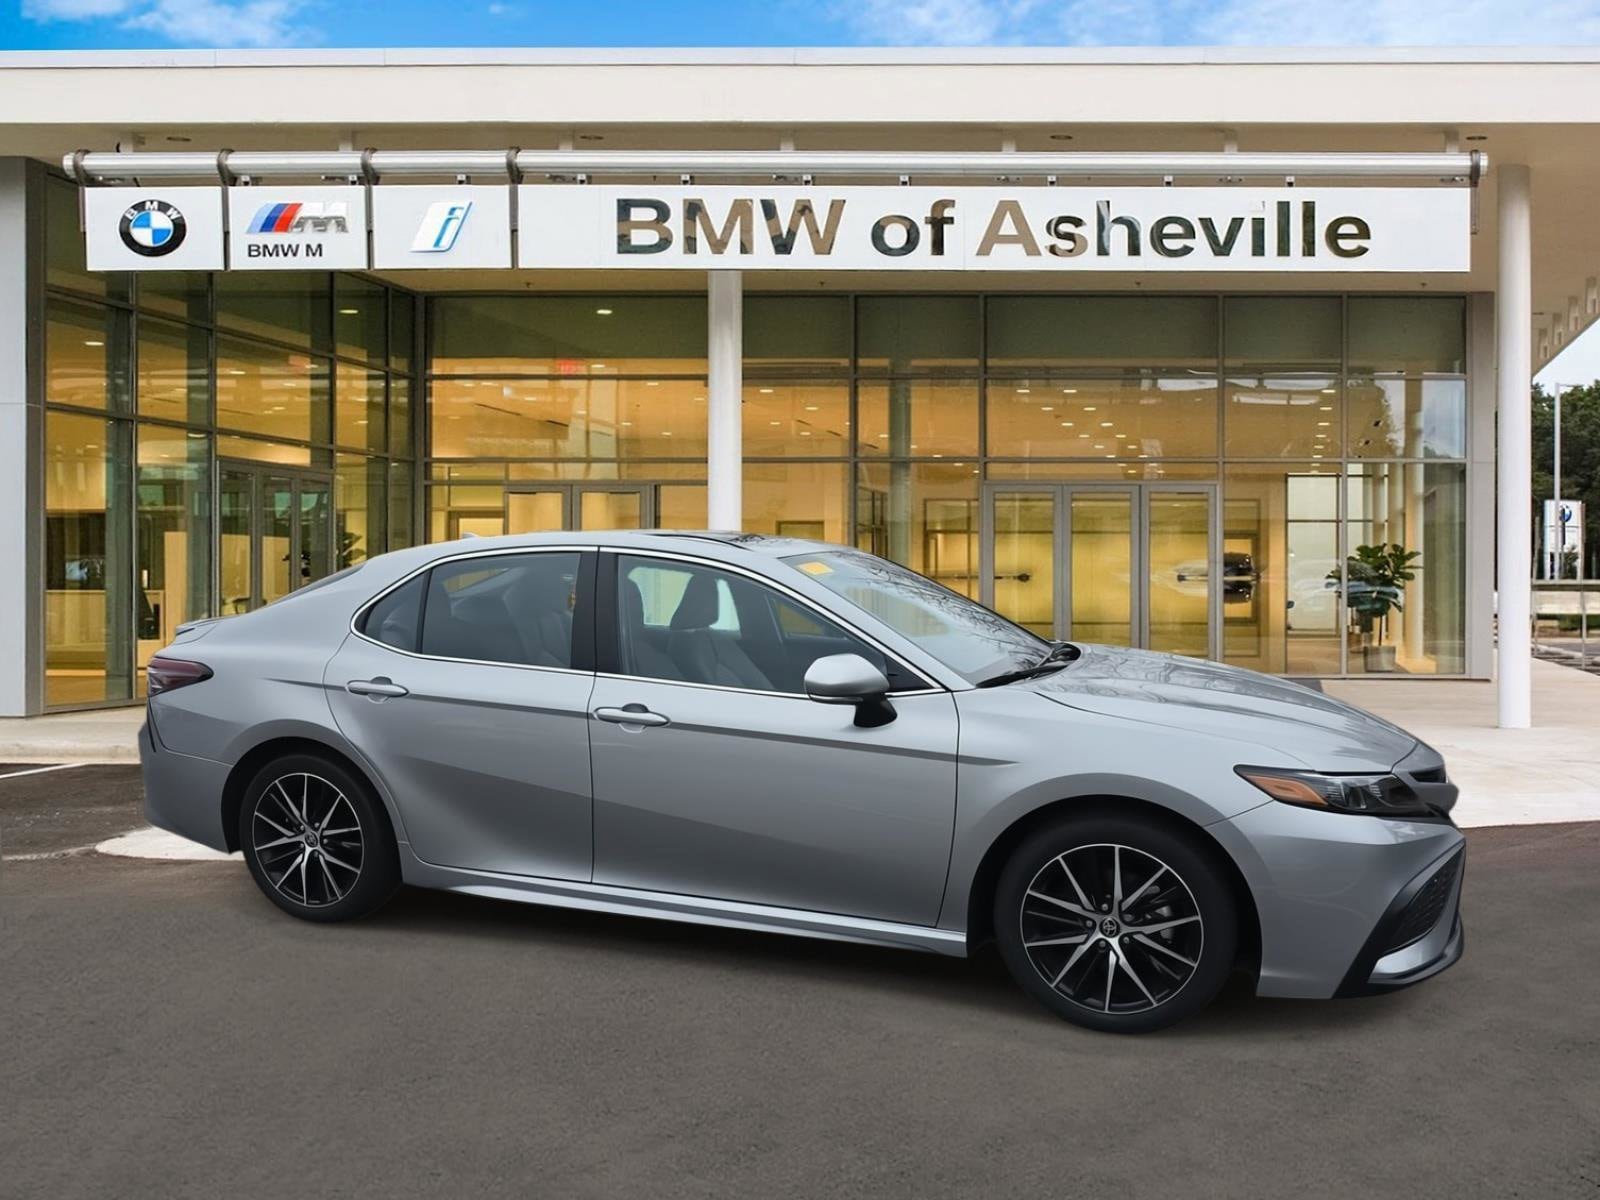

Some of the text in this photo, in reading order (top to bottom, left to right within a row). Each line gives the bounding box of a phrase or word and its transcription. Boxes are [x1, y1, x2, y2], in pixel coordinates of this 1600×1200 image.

[124, 200, 182, 220] BMW
[616, 198, 1372, 258] BMW of Asheville
[247, 243, 323, 258] BMW M
